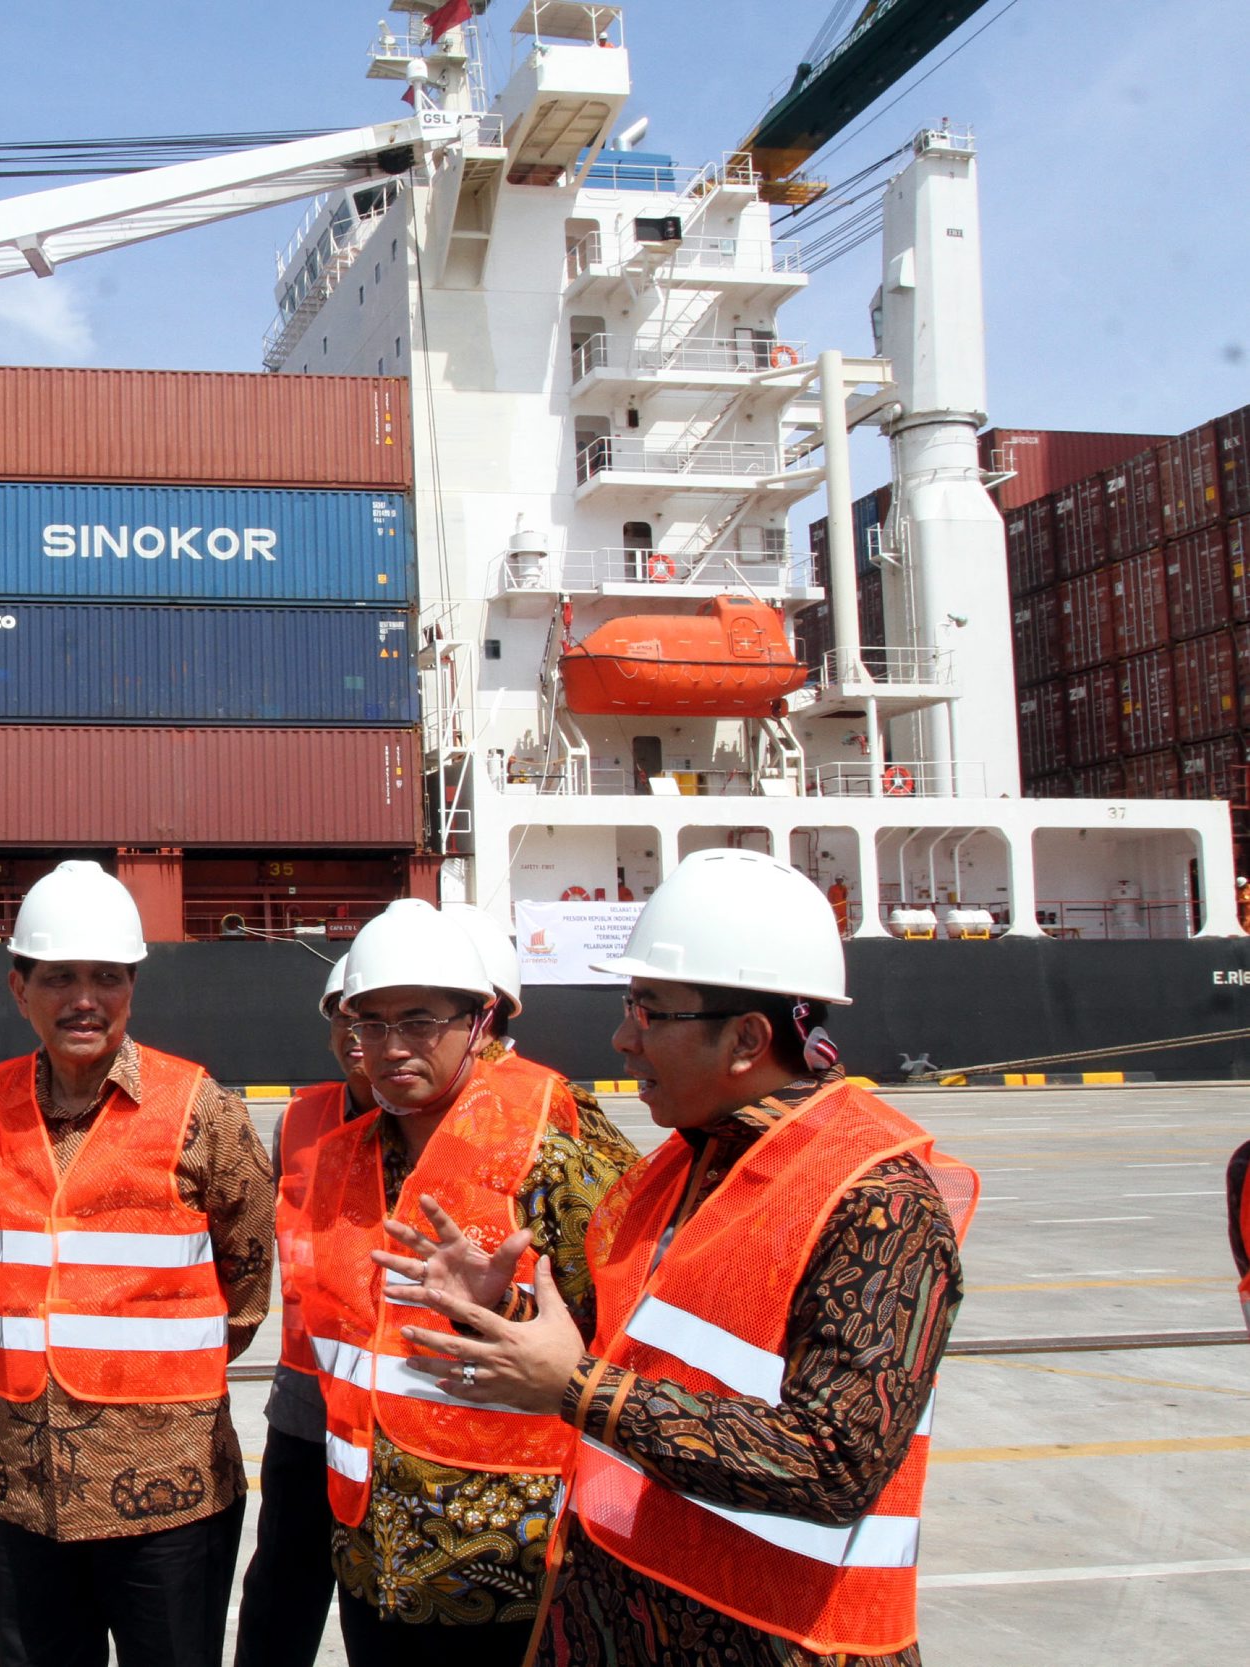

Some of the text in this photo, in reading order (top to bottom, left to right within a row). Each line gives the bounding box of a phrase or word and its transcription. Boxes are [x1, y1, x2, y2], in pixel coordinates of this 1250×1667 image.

[424, 114, 451, 124] GSL
[43, 524, 276, 560] SINOKOR
[1108, 806, 1126, 819] 37
[270, 863, 294, 876] 35
